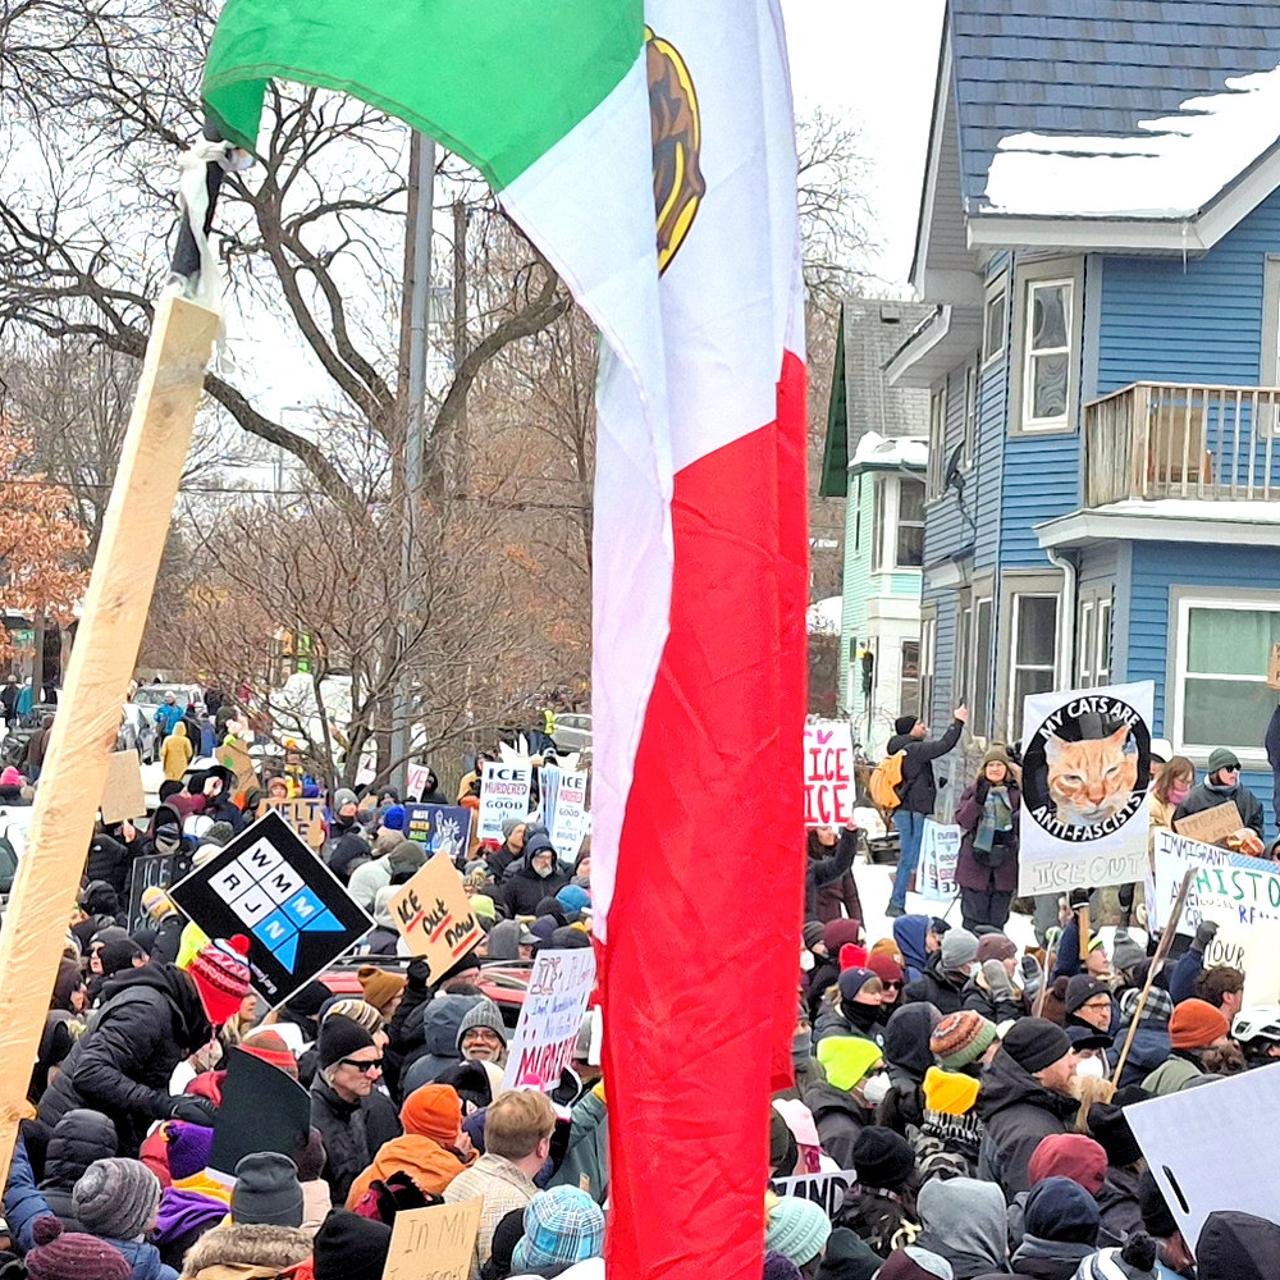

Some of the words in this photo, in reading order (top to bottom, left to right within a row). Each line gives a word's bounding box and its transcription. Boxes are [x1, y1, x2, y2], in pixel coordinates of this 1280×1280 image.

[1039, 710, 1063, 740] MY
[1067, 696, 1110, 718] CATS
[1110, 701, 1141, 730] ARE
[488, 767, 527, 781] ICE
[808, 747, 850, 781] ICE
[484, 782, 528, 795] MURDERED
[561, 775, 583, 789] ICE
[486, 800, 523, 810] GOOD
[1032, 792, 1142, 841] ANTI-FASCISTS
[143, 859, 171, 888] ICE
[396, 888, 423, 925] ICE
[403, 1218, 429, 1254] In
[437, 1211, 471, 1250] MN
